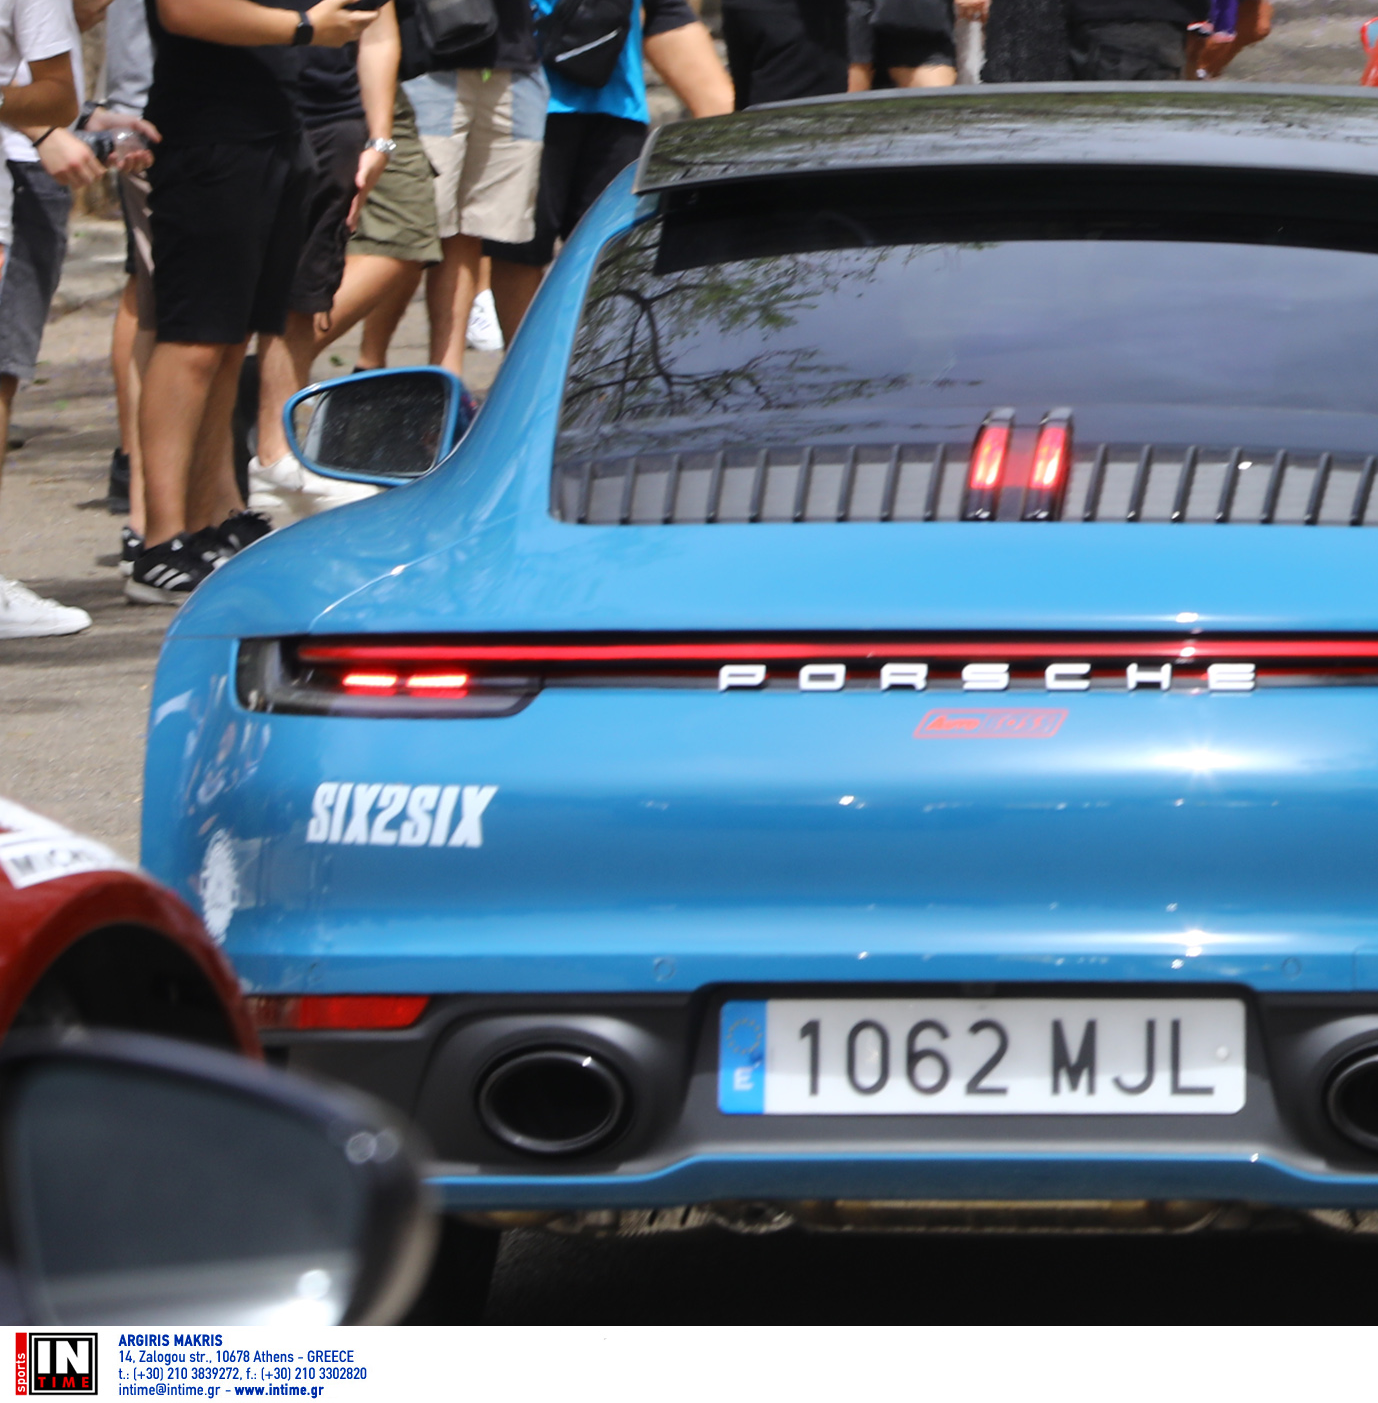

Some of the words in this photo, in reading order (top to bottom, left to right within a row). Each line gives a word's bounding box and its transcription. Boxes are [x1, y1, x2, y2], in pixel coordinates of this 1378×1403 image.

[718, 662, 1256, 692] PORSCHE
[306, 781, 500, 849] SIX2SIX
[733, 1066, 753, 1092] E
[797, 1018, 1009, 1097] 1062
[1050, 1018, 1215, 1097] MJL
